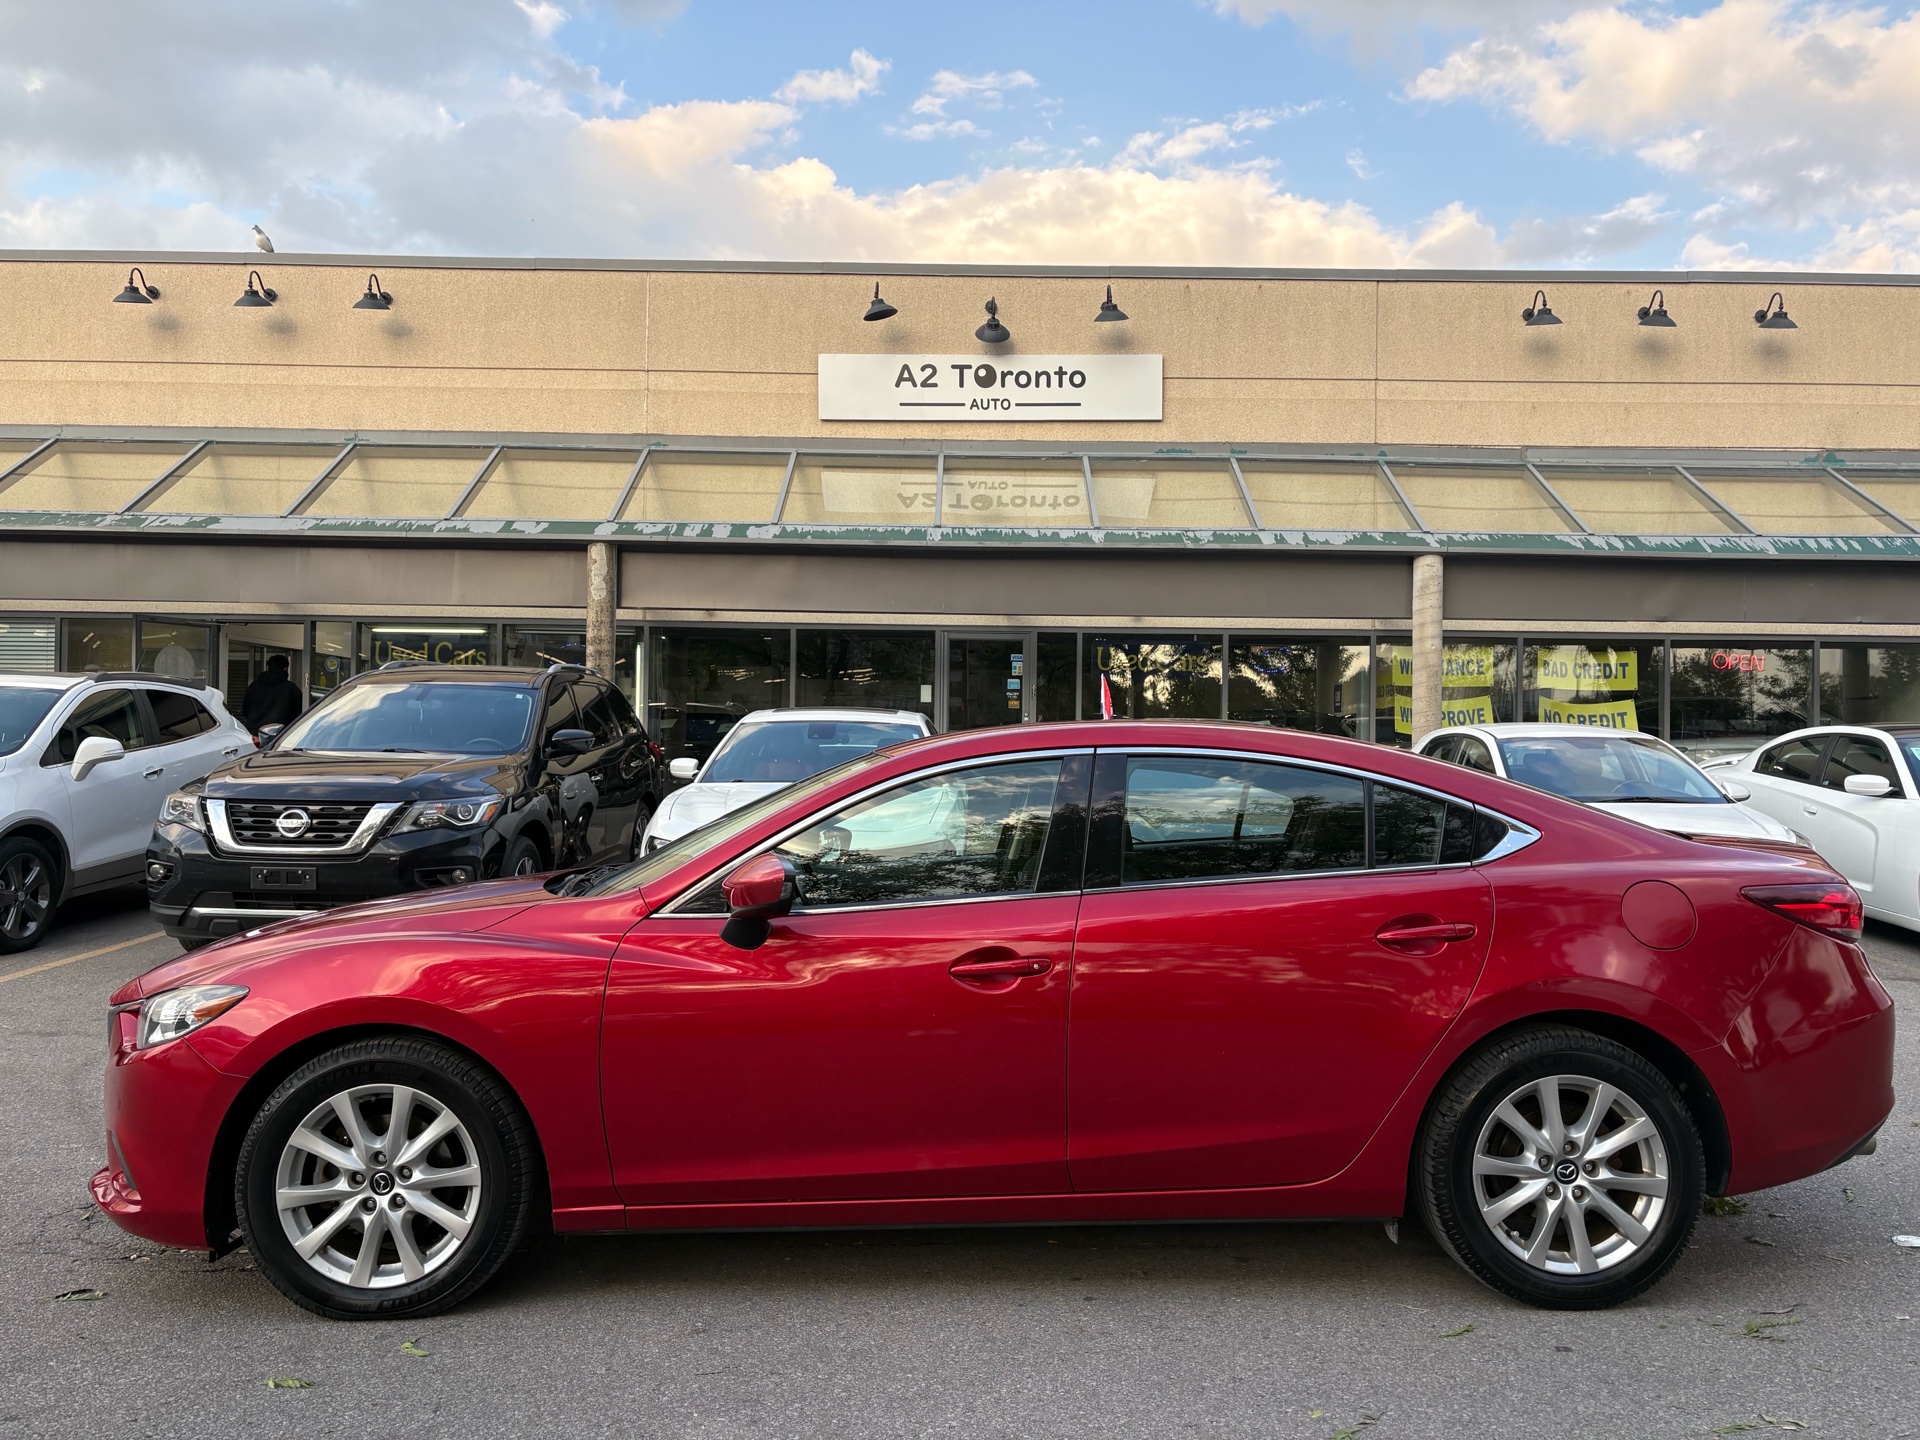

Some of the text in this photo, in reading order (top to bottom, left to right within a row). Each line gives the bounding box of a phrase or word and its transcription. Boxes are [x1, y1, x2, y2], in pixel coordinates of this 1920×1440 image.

[895, 363, 938, 388] A2
[969, 398, 1011, 410] AUTO
[375, 641, 487, 665] Used Cars
[1096, 646, 1151, 672] Ued
[1712, 652, 1766, 672] OPEN
[1399, 658, 1486, 676] W ANCE
[1543, 660, 1629, 680] BAD CREDIT
[1399, 705, 1412, 724] W
[1543, 709, 1627, 729] NO CREDIT
